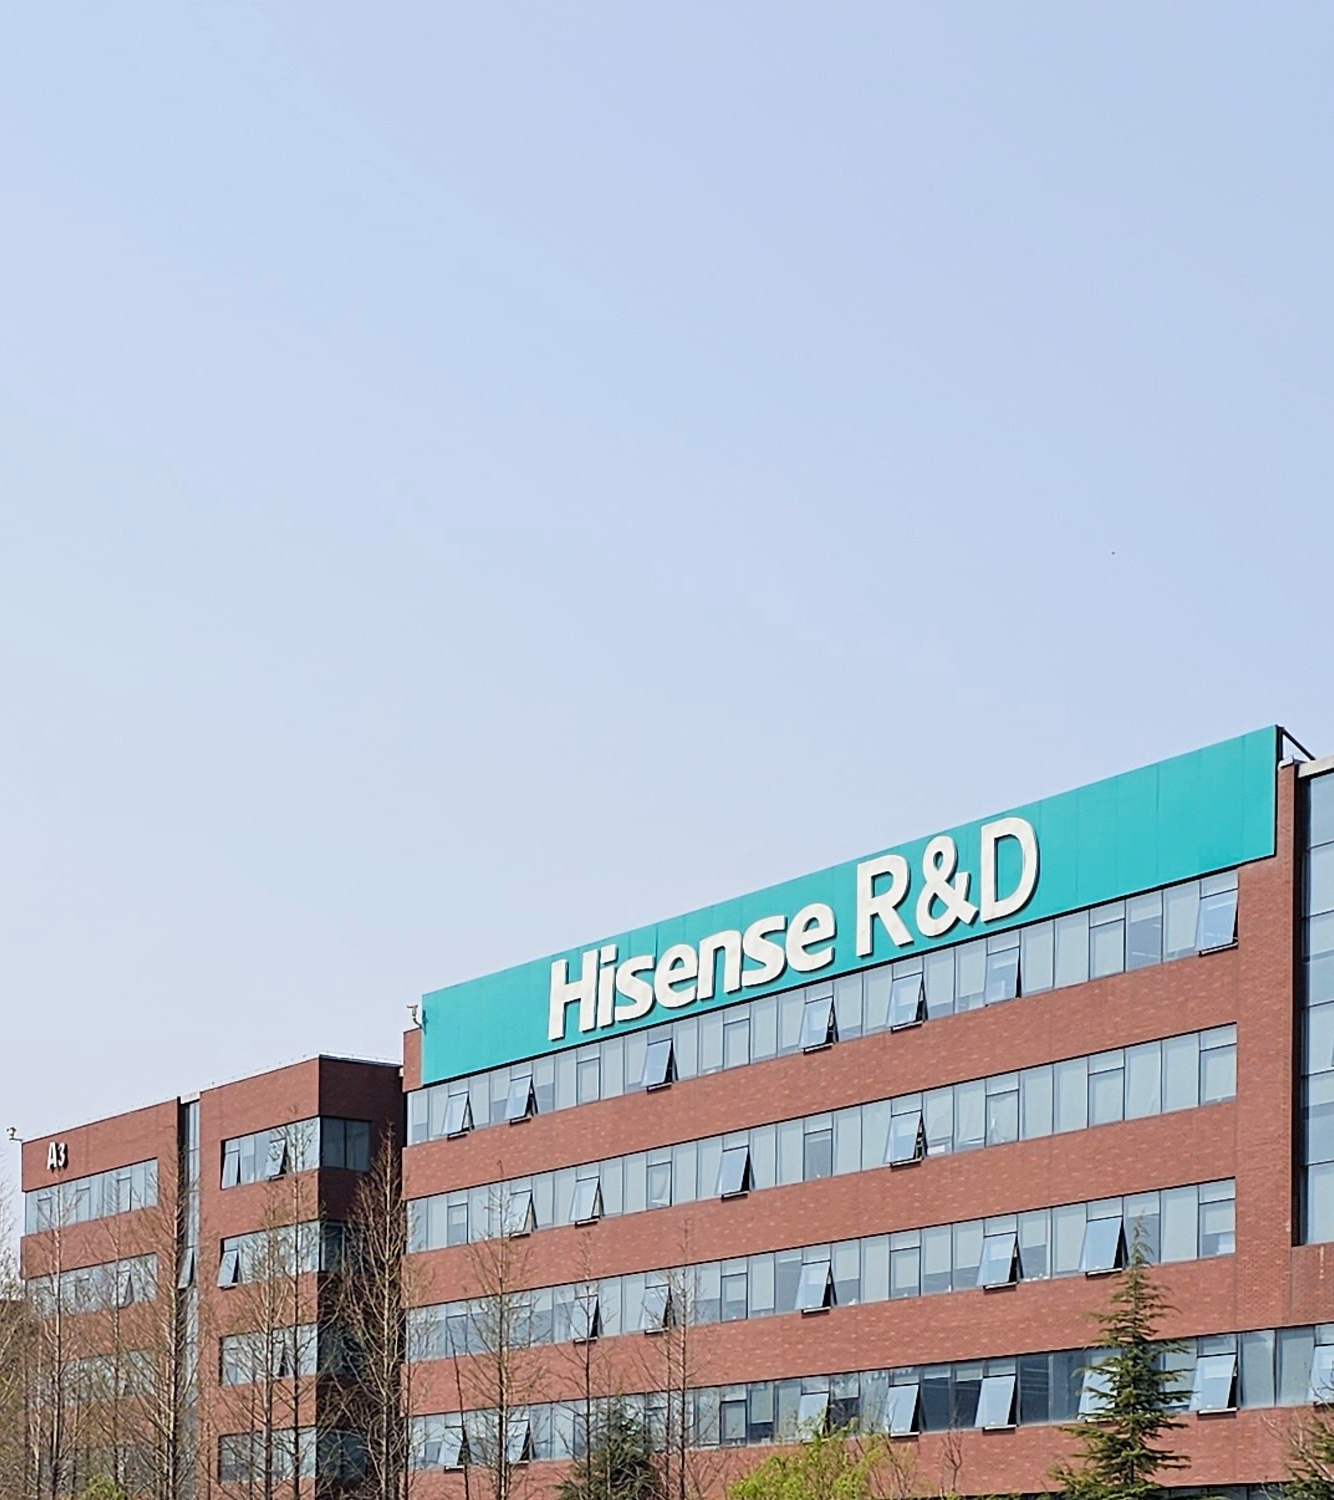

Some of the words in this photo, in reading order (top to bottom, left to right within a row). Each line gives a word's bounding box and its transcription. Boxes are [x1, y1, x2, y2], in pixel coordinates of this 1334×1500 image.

[548, 903, 836, 1041] Hisense
[855, 816, 1041, 957] R&D
[47, 1141, 66, 1170] A3
